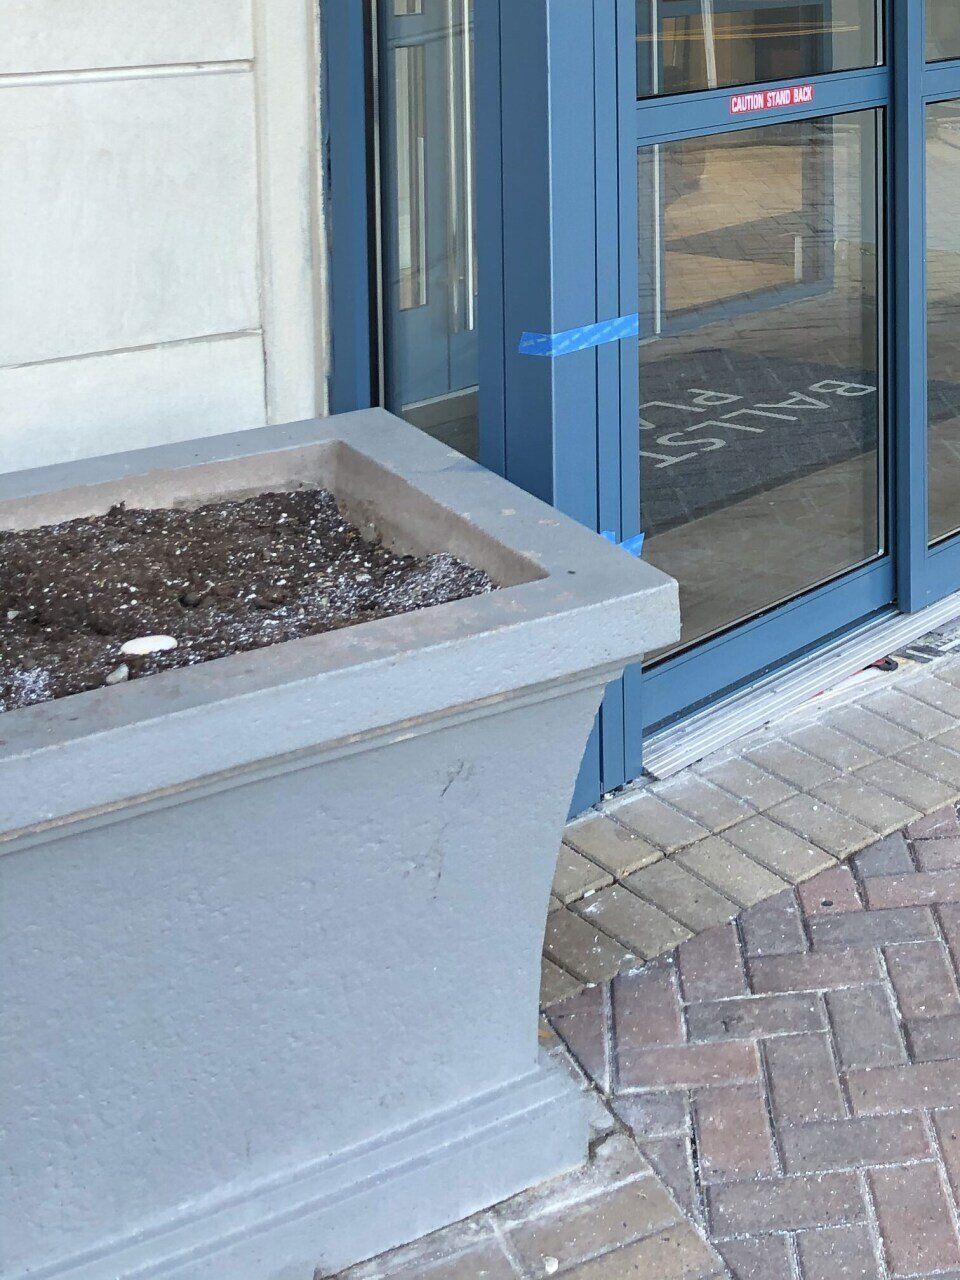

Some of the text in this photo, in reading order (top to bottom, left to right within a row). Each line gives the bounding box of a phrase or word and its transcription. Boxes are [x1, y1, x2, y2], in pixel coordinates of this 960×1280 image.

[731, 86, 812, 112] CAUTION STAND BACK
